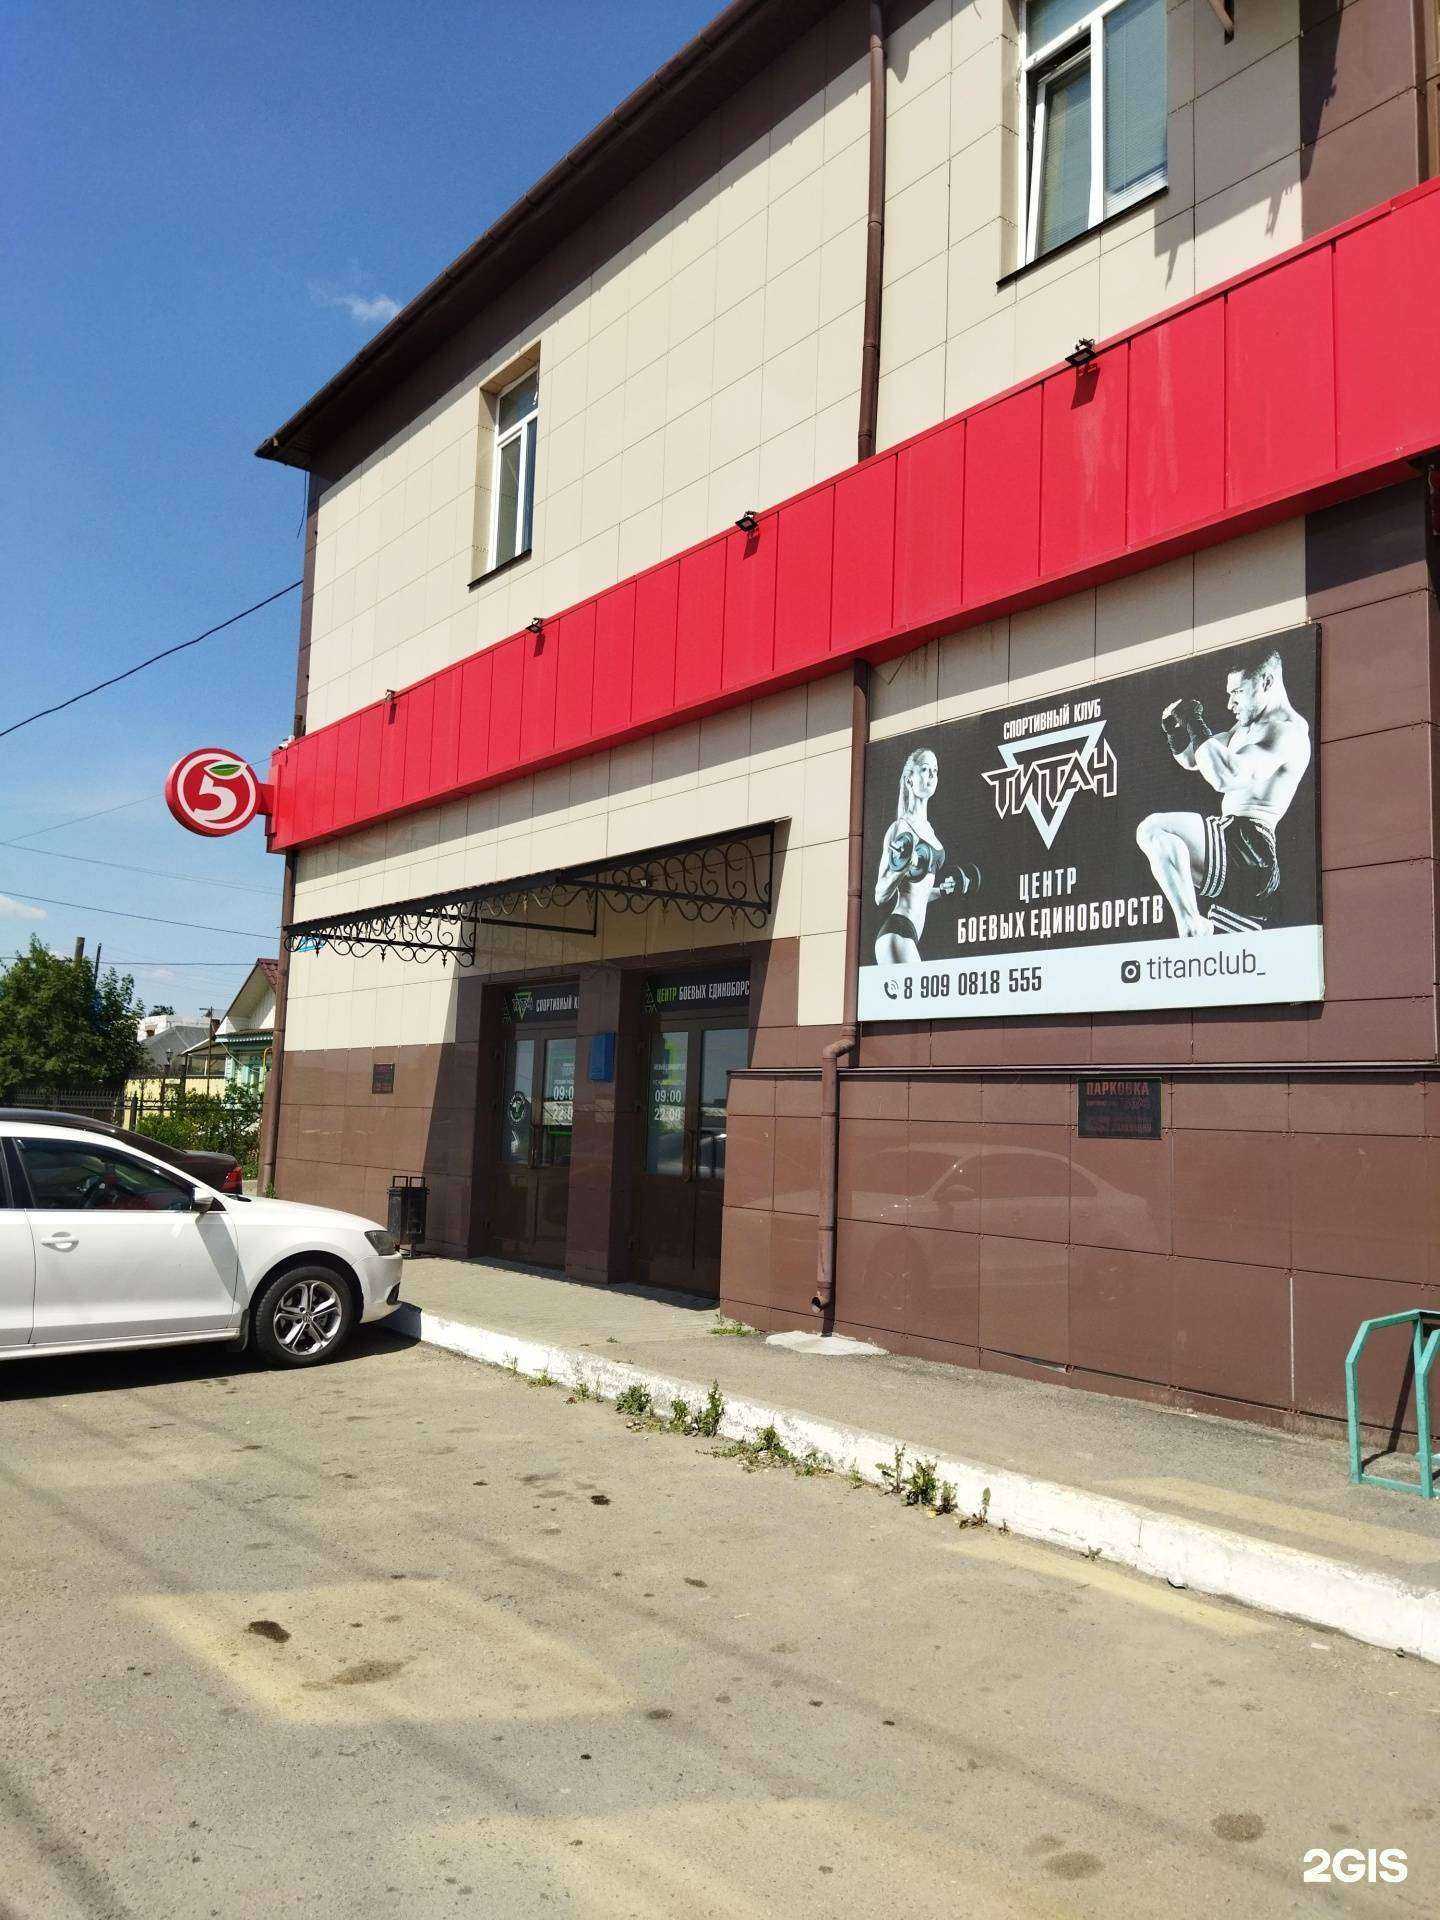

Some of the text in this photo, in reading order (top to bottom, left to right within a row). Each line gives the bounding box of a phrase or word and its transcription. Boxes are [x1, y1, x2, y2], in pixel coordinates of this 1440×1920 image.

[1003, 699, 1101, 740] СПОРТИВНЫЙ КЛУБ
[193, 765, 240, 821] 5
[981, 738, 1118, 820] ТИТАН
[1019, 867, 1077, 904] ЦЕНТР
[957, 894, 1164, 944] БОЕВЫХ ЕДИНОБОРСТВ
[1147, 949, 1266, 980] titanclub_
[656, 980, 750, 1004] ЦЕНТР БОЕВЫХ ЕДИНОБОРС
[904, 966, 1042, 999] 8 909 0818 555
[553, 1086, 575, 1100] 09:0
[654, 1089, 682, 1103] 09:00
[1087, 1082, 1149, 1096] ПАРКОВКА
[552, 1104, 573, 1120] 22:0
